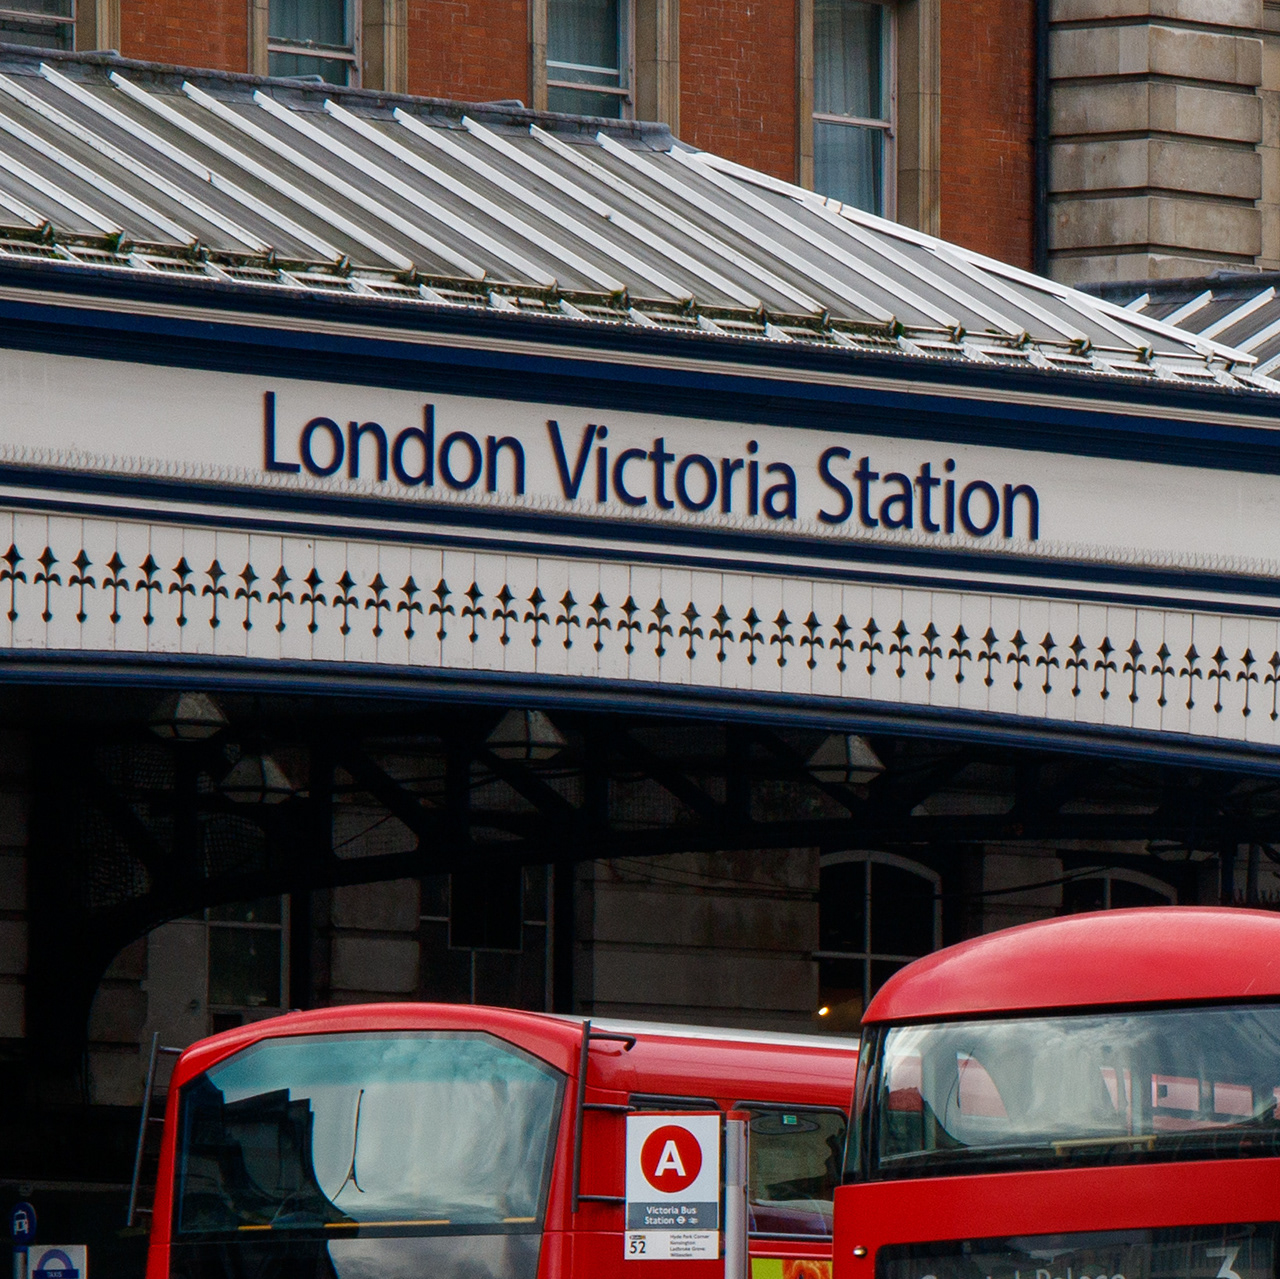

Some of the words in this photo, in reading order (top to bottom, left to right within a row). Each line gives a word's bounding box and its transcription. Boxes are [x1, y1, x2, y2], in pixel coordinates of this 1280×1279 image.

[264, 390, 526, 496] London
[547, 418, 799, 522] Victoria
[817, 445, 1041, 541] Station
[654, 1139, 687, 1177] A
[646, 1206, 679, 1215] Victoria
[681, 1206, 697, 1215] Bus
[644, 1216, 674, 1225] Station
[629, 1240, 646, 1254] 52
